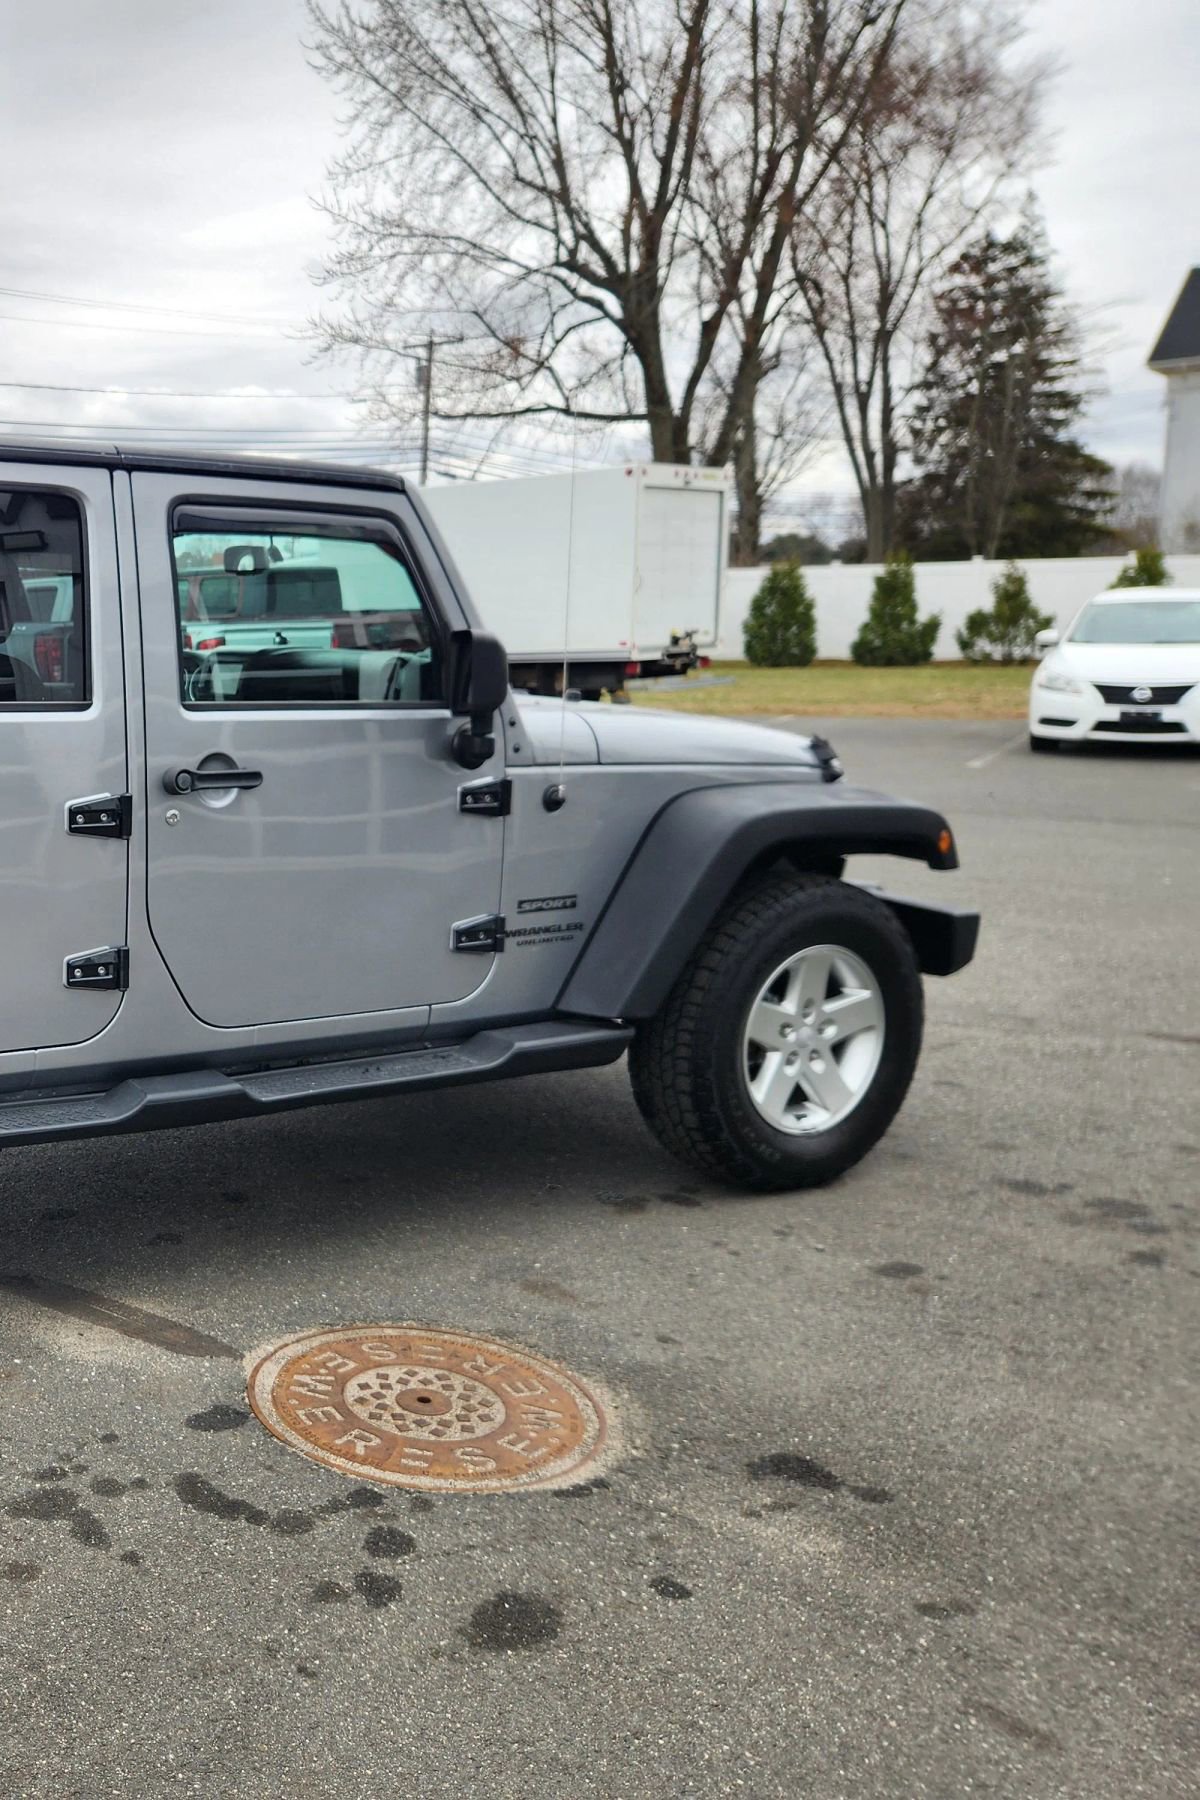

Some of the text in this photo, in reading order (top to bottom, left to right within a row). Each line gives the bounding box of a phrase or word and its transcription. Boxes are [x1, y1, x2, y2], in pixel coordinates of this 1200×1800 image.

[519, 897, 575, 911] SPORT
[505, 922, 583, 937] WRANGLER
[516, 935, 574, 946] UNLIMITED
